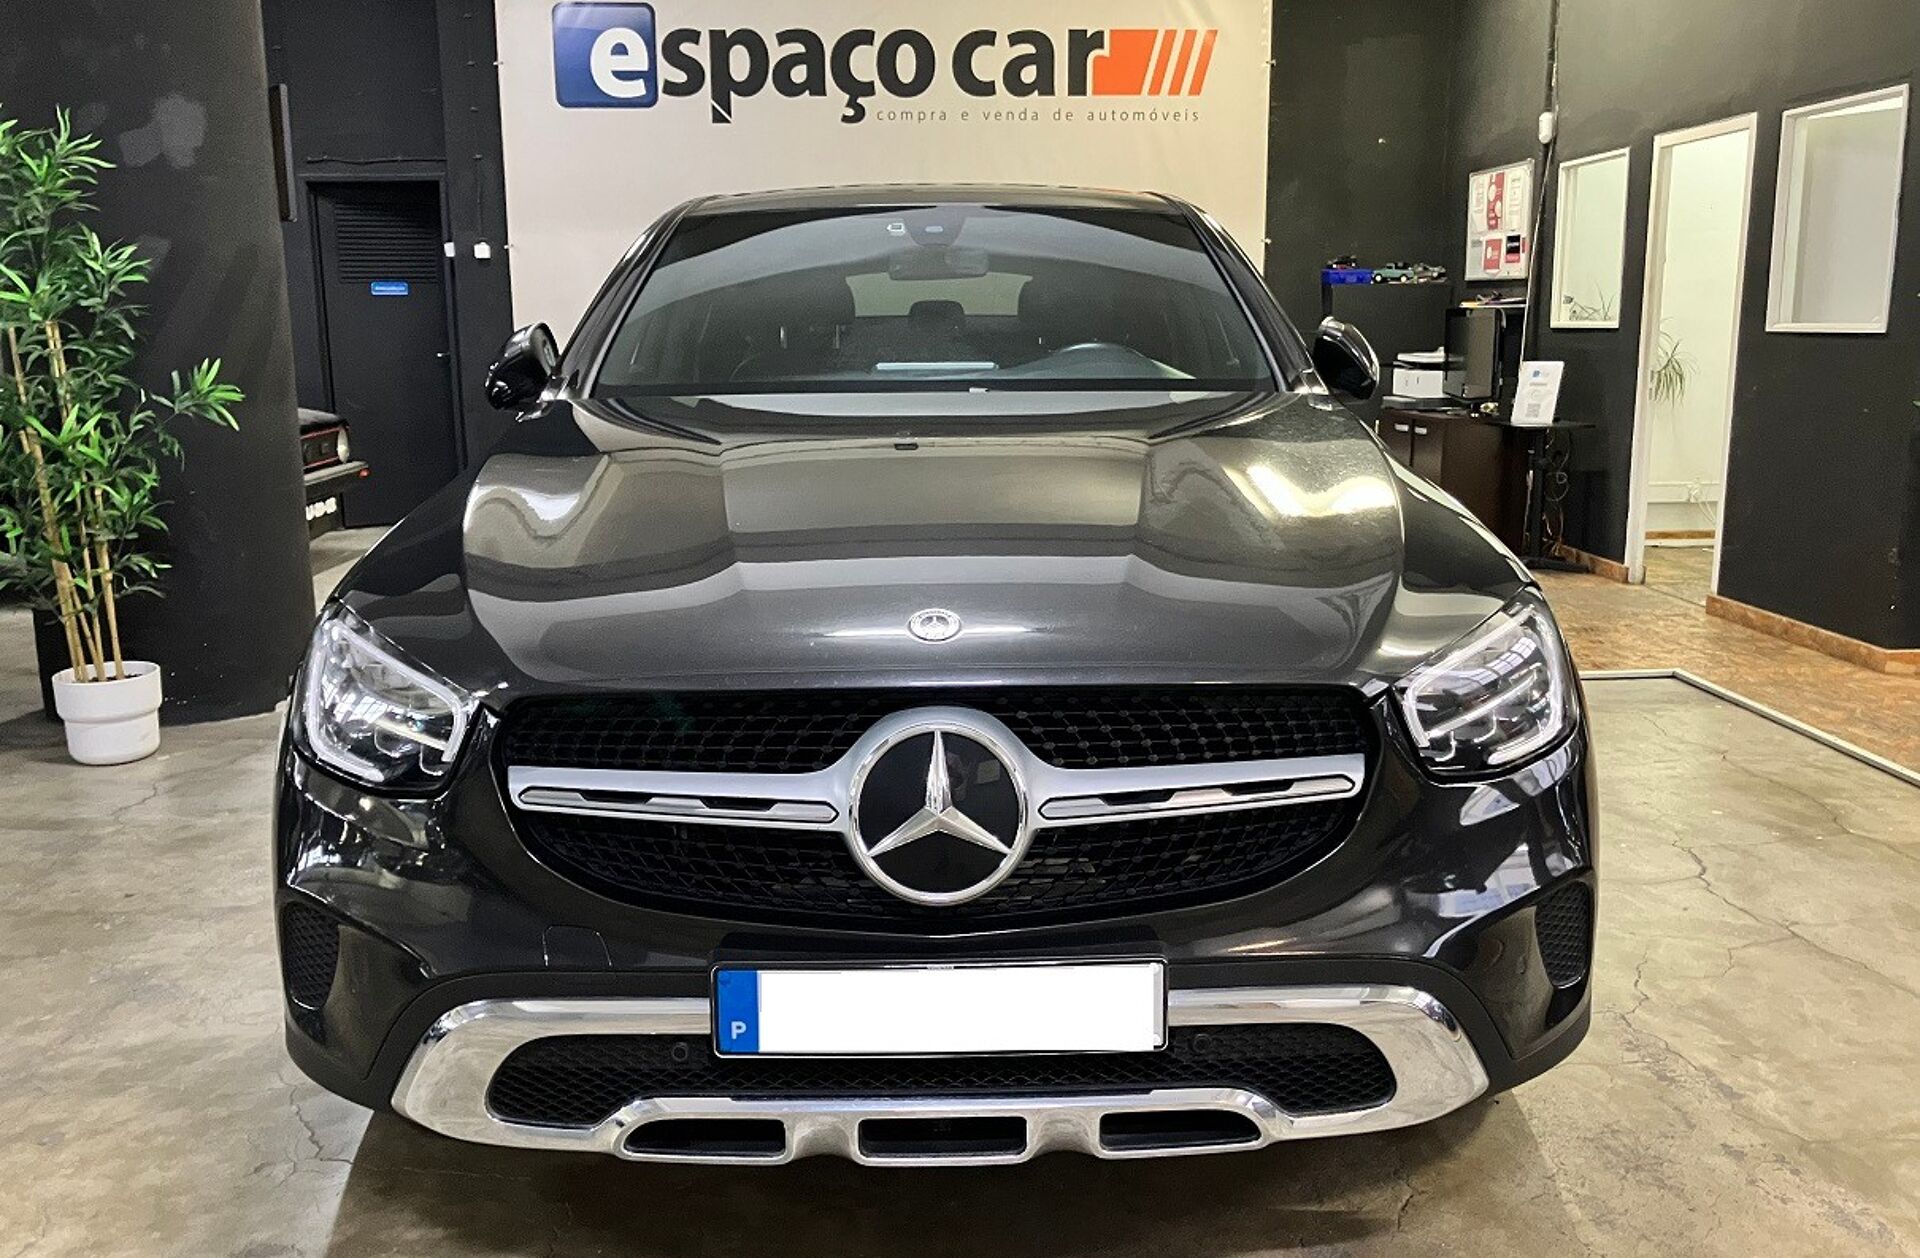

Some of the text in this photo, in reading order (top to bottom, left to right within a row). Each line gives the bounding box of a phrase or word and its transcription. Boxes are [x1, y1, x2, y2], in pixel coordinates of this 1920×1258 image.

[589, 27, 1106, 124] espaço car
[876, 106, 1200, 124] compra e venda de automóveis
[731, 1020, 747, 1040] P
